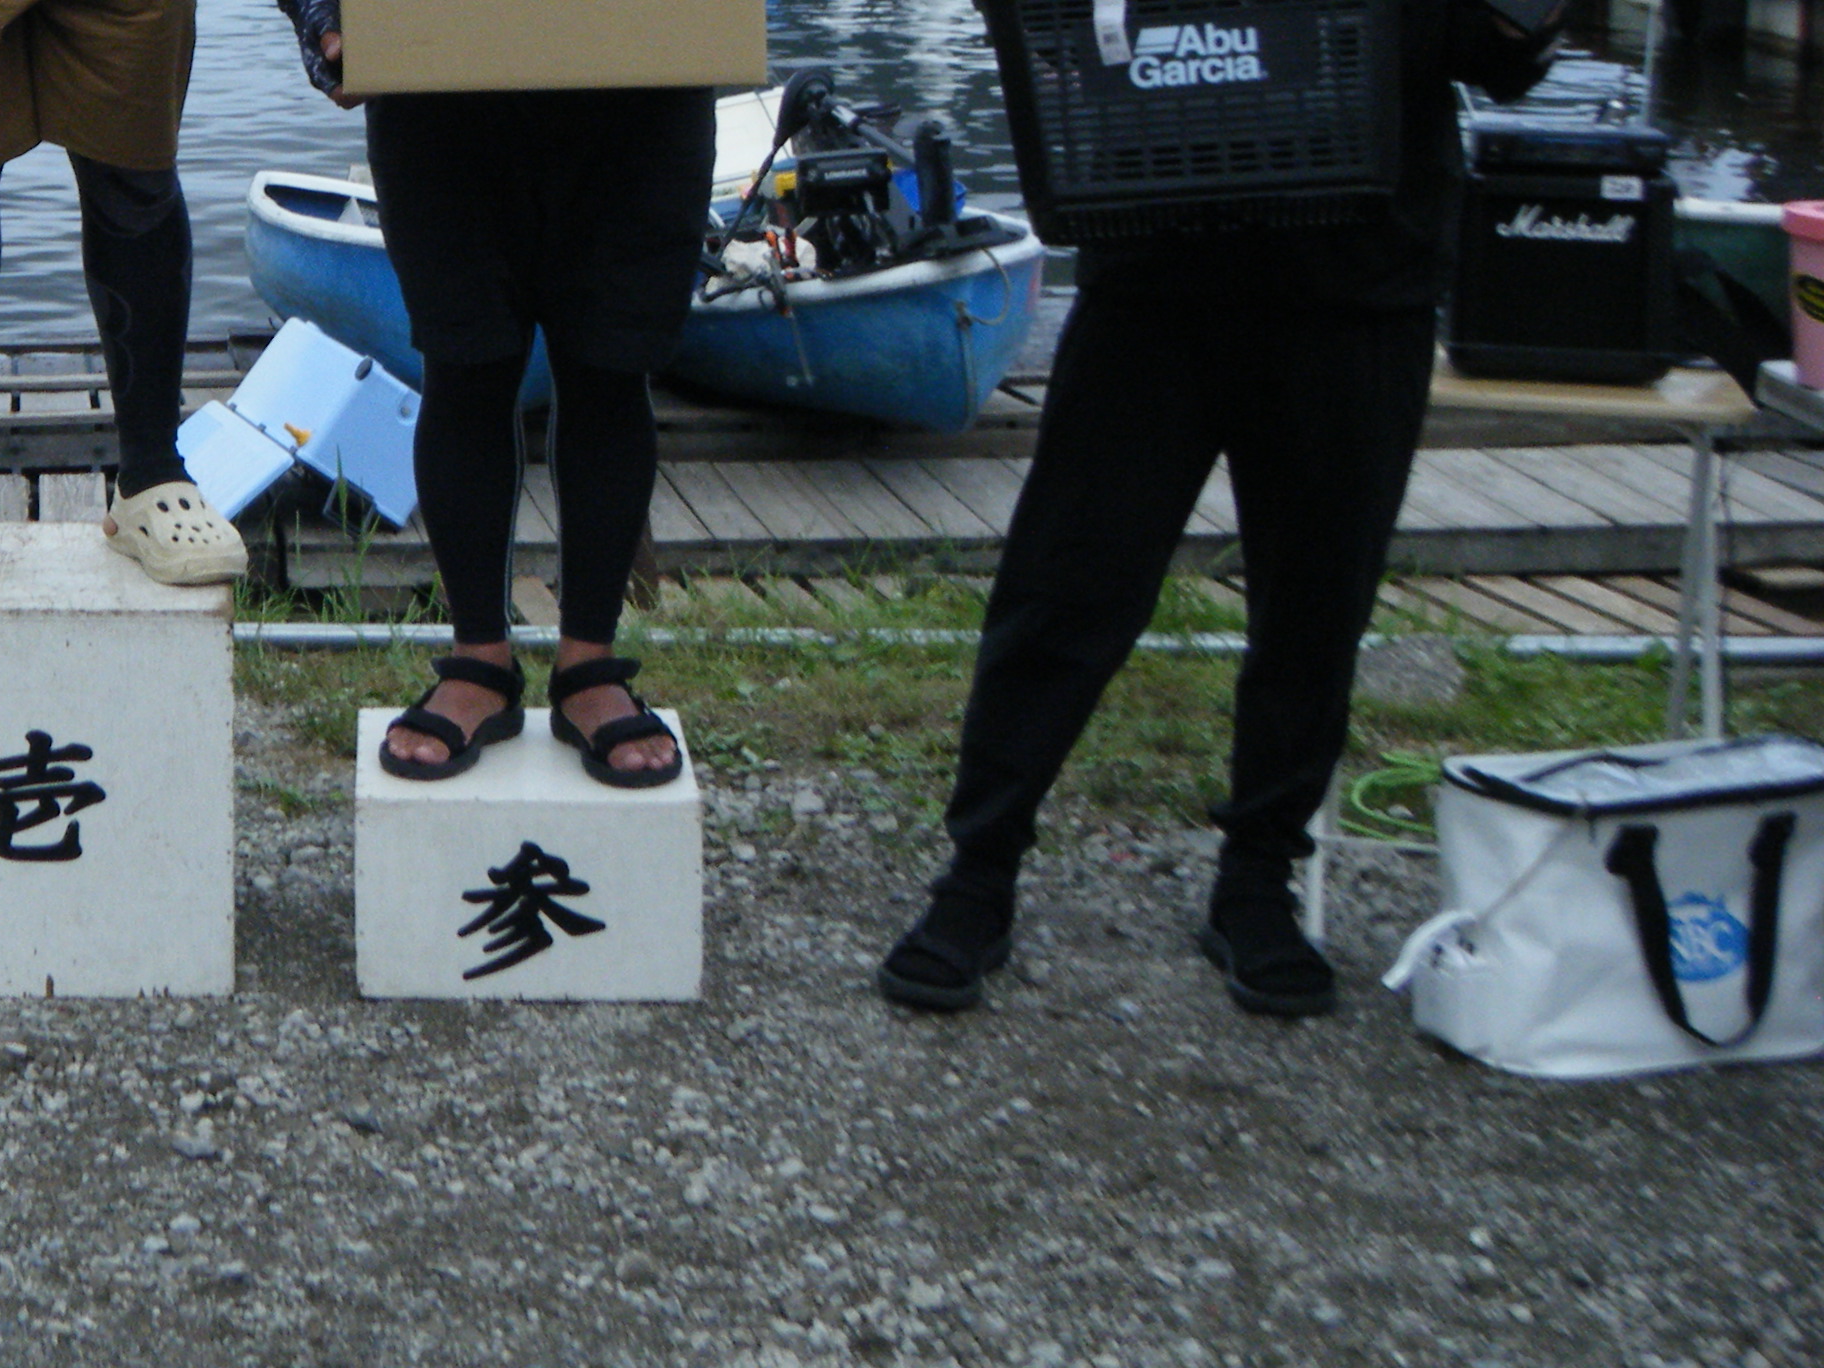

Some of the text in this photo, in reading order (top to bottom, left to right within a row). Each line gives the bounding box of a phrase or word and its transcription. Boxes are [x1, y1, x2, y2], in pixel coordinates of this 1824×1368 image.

[1176, 23, 1259, 57] Abu
[1128, 53, 1262, 89] Garcia
[1495, 203, 1636, 243] Marshall
